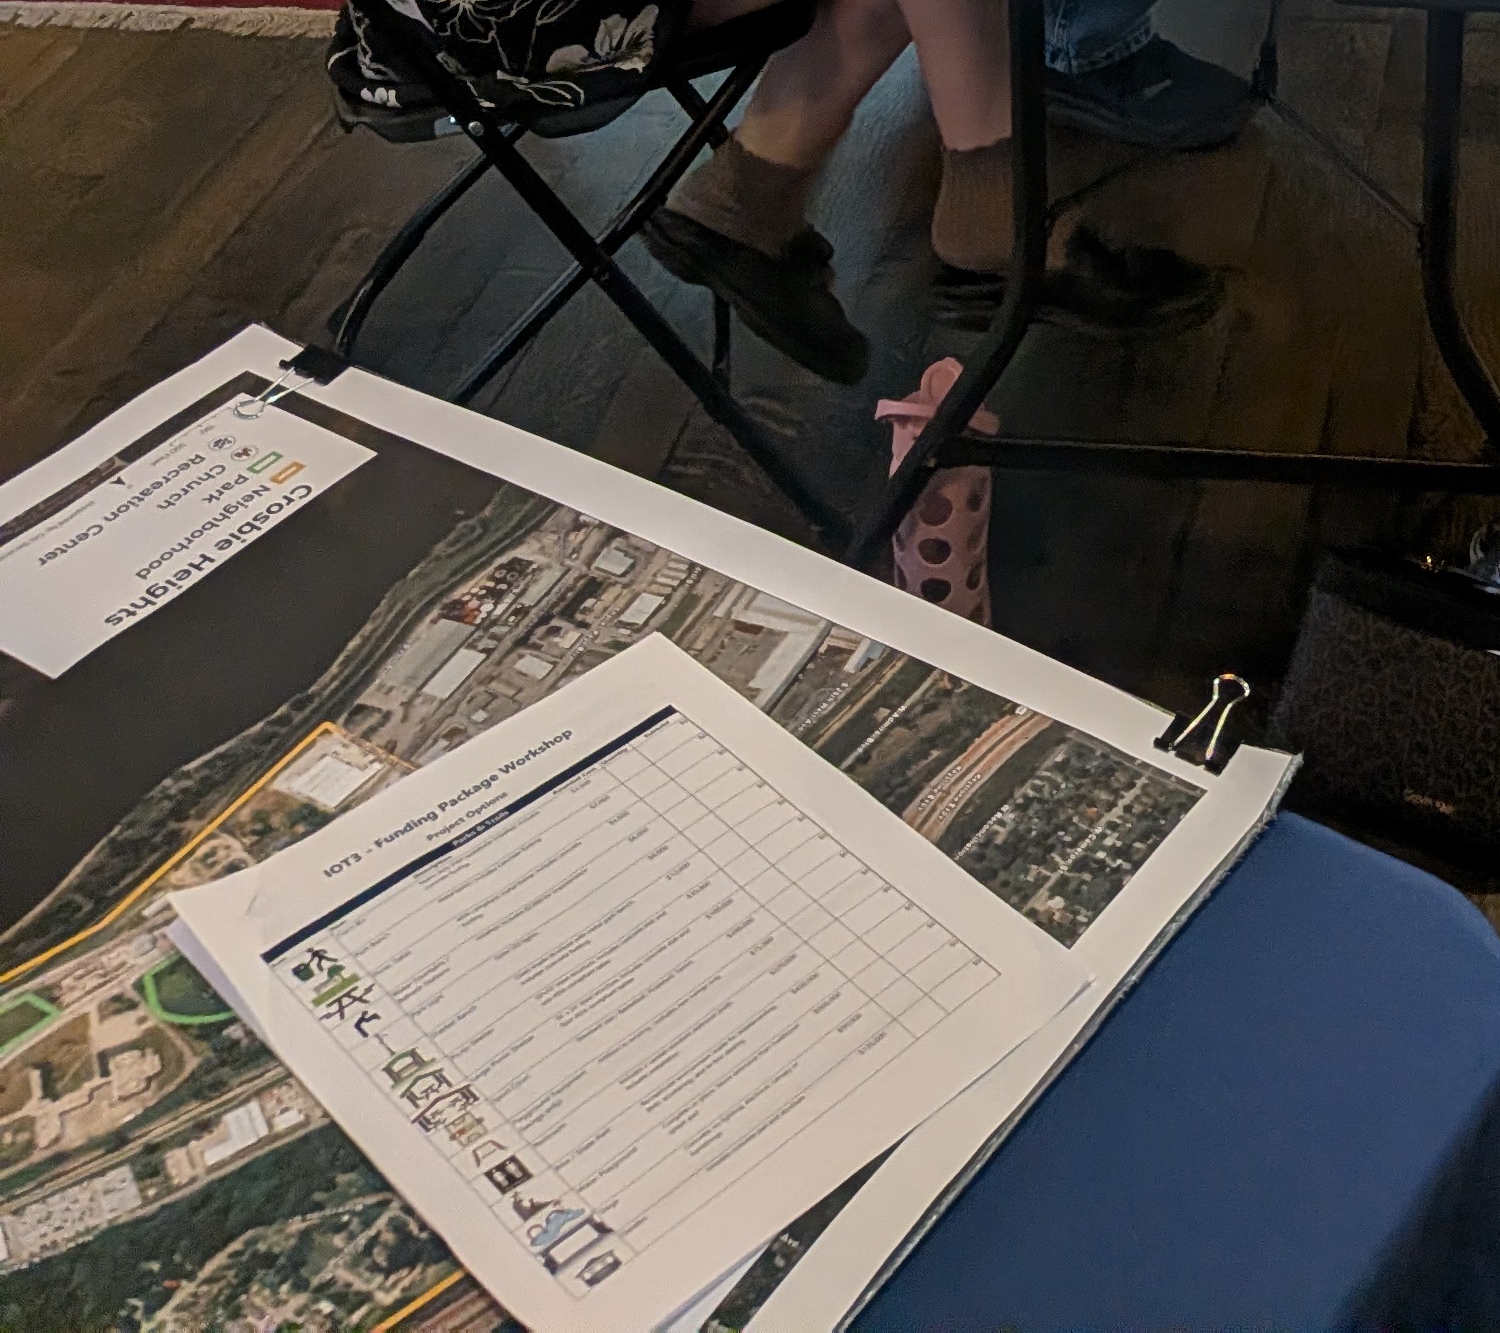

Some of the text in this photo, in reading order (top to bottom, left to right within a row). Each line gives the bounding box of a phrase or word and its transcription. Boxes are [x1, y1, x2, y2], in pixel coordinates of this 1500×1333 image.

[103, 453, 206, 525] Recreation
[156, 463, 228, 510] Church
[201, 472, 249, 505] Park
[38, 523, 104, 566] Center
[104, 483, 314, 626] Crosbie Heights
[136, 483, 270, 580] Neighborhood
[323, 852, 364, 879] IOT3
[374, 809, 439, 850] Funding
[438, 772, 500, 813] Package
[500, 727, 573, 776] Workshop
[426, 789, 508, 842] Project Options
